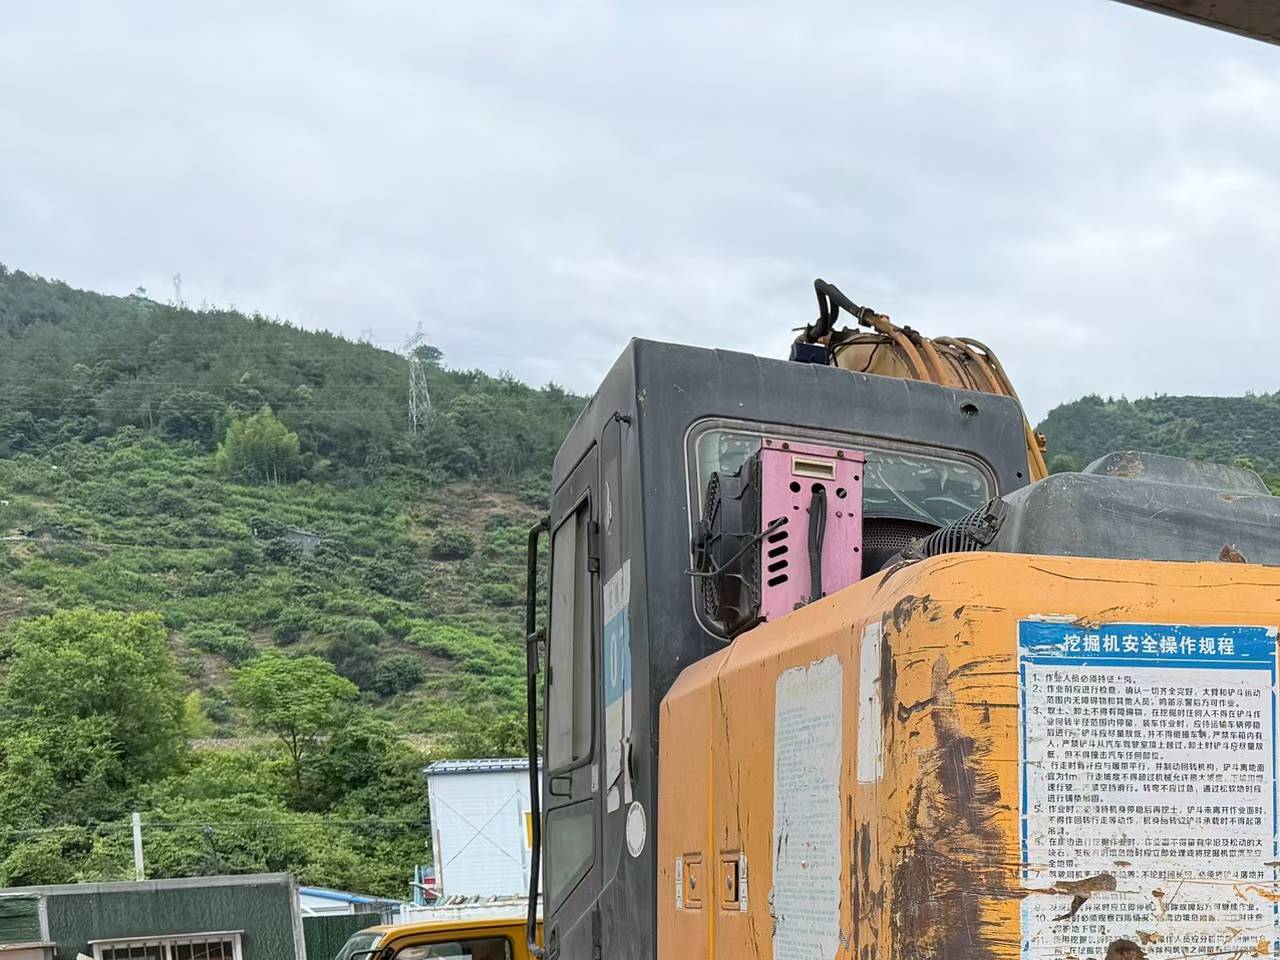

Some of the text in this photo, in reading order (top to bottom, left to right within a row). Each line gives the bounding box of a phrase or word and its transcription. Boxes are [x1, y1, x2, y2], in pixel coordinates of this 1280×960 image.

[1063, 634, 1236, 656] 挖掘机安全操作规程
